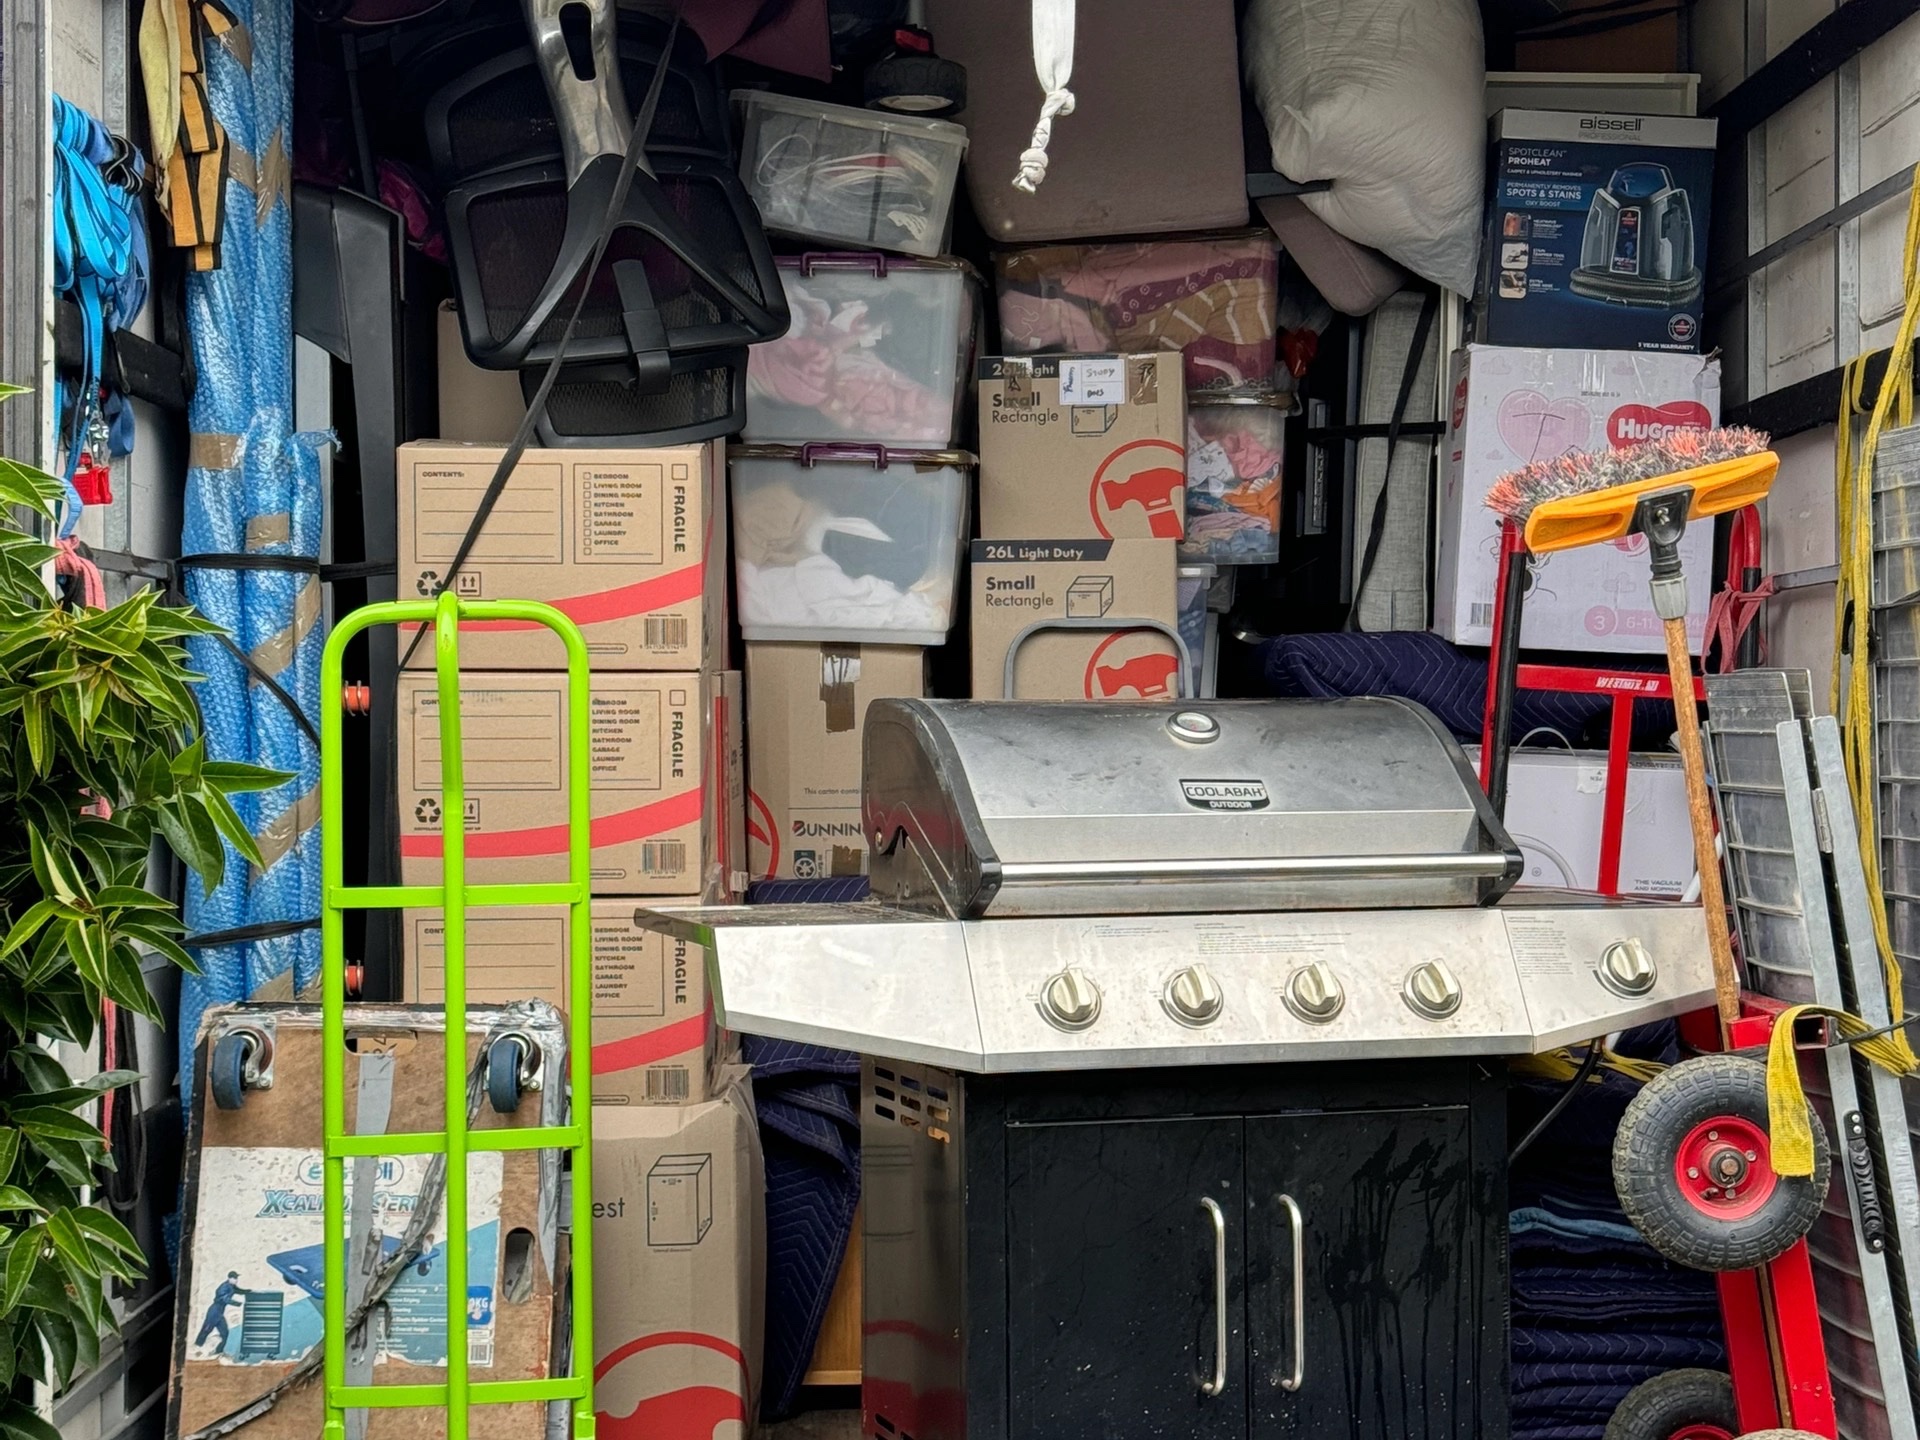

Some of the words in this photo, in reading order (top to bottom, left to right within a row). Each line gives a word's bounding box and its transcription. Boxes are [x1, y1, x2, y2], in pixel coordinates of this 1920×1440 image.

[1507, 156, 1552, 166] PROHEAT
[1506, 188, 1537, 197] SPOTS
[1538, 189, 1545, 197] &
[1548, 190, 1582, 200] STAINS
[1551, 183, 1582, 191] REMOVES
[992, 408, 1059, 425] Rectangle
[674, 485, 686, 553] FRAGILE
[985, 546, 1015, 559] 26L
[1019, 547, 1049, 561] Light
[1053, 548, 1084, 561] Duty
[985, 575, 1035, 591] Small
[985, 592, 1054, 610] Rectangle
[1594, 615, 1605, 630] 3
[672, 711, 684, 778] FRAGILE
[804, 787, 817, 795] This
[792, 820, 861, 837] BUNNIN
[675, 938, 686, 1004] FRAGILE
[591, 1197, 626, 1219] est
